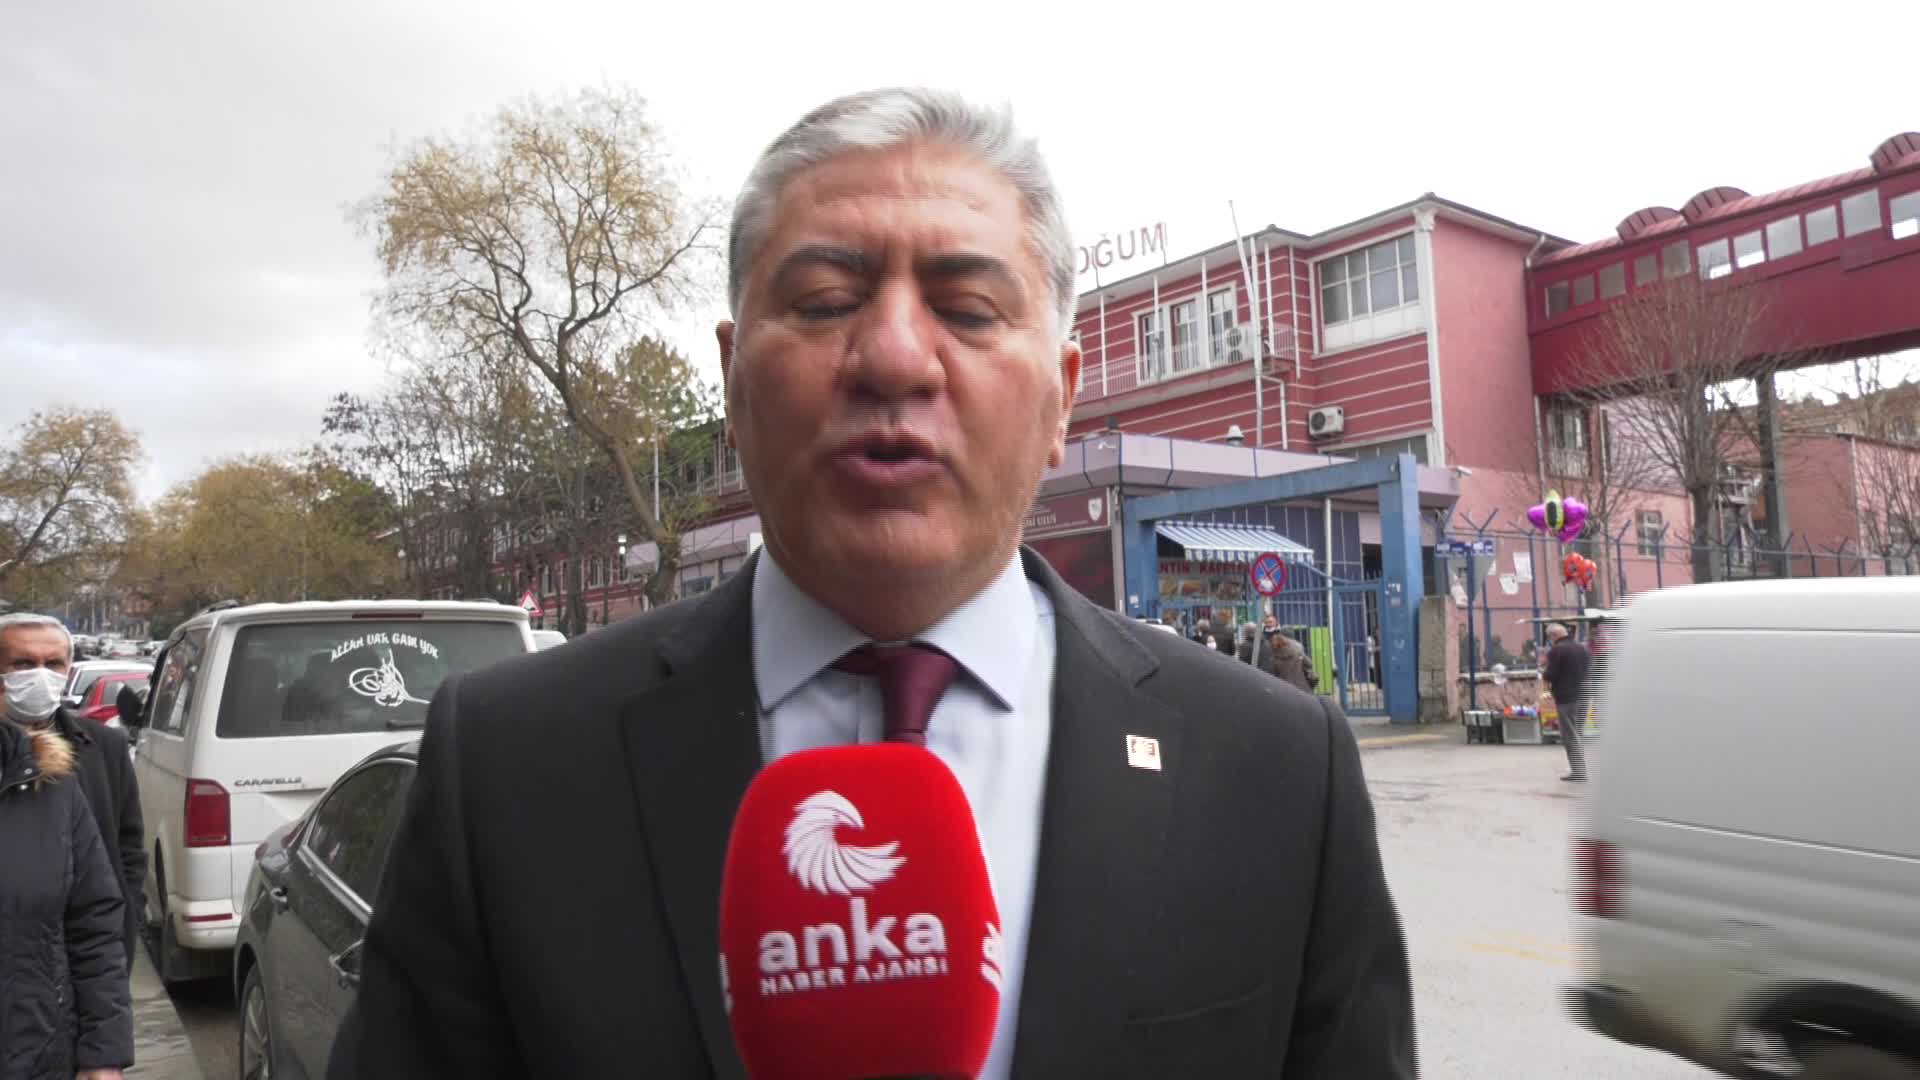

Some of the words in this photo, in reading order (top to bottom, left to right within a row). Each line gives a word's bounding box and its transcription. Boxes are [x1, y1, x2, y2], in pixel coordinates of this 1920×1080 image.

[759, 897, 947, 975] anka
[760, 967, 846, 997] HABER
[853, 957, 949, 983] AJANSI
